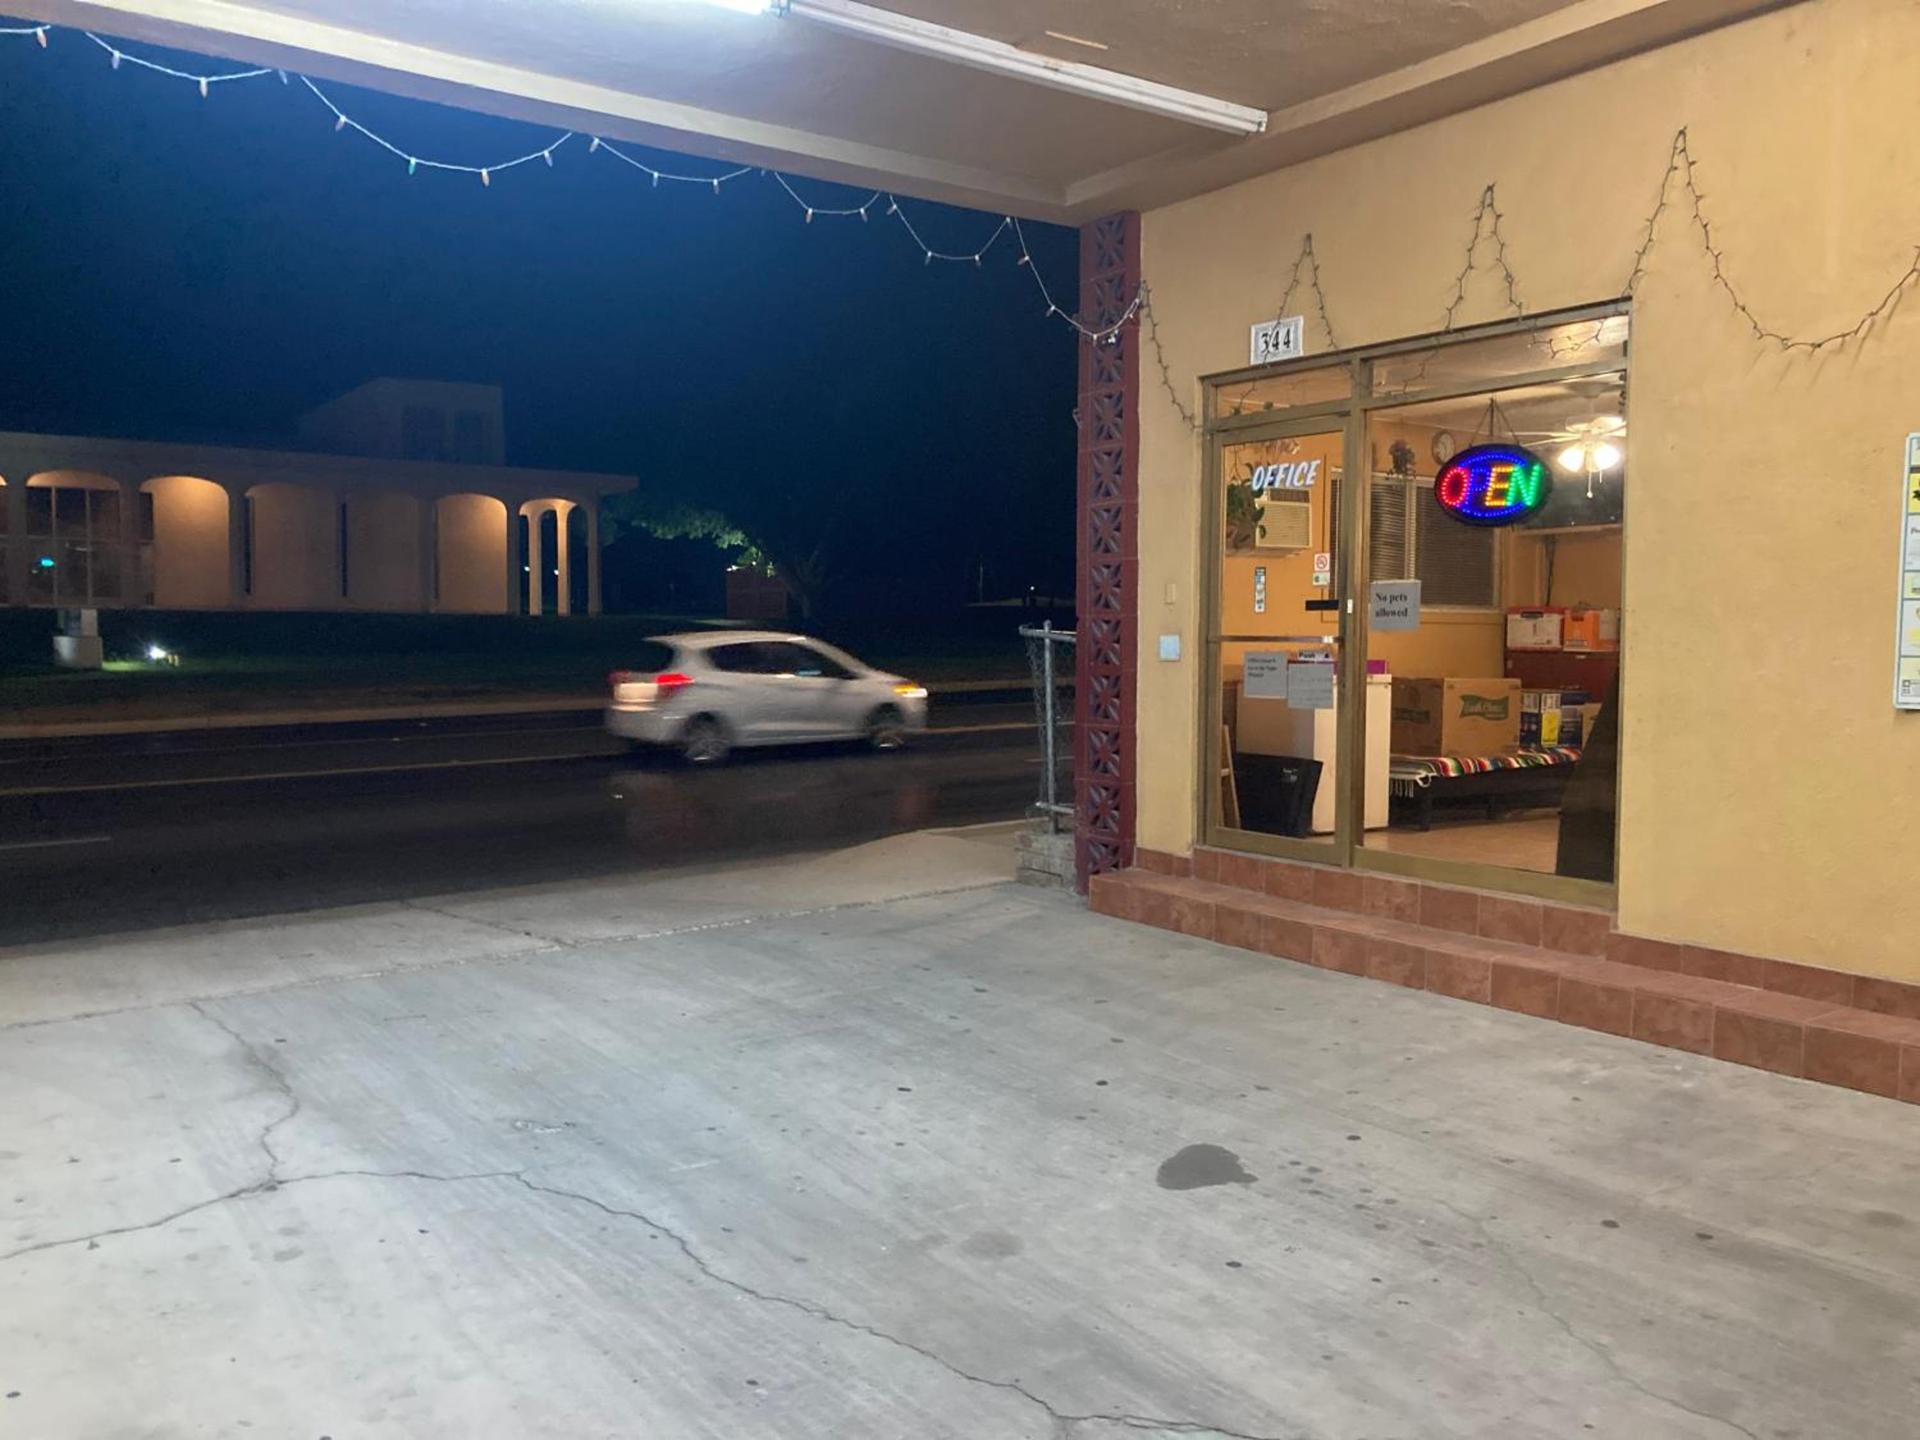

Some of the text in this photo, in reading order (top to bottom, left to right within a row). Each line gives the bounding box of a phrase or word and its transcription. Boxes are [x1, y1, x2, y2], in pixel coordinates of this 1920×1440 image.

[1261, 327, 1291, 353] 344
[1252, 459, 1321, 491] OFFICE
[1440, 463, 1542, 508] OPEN
[1389, 592, 1408, 605] pets
[1375, 607, 1408, 618] allowed
